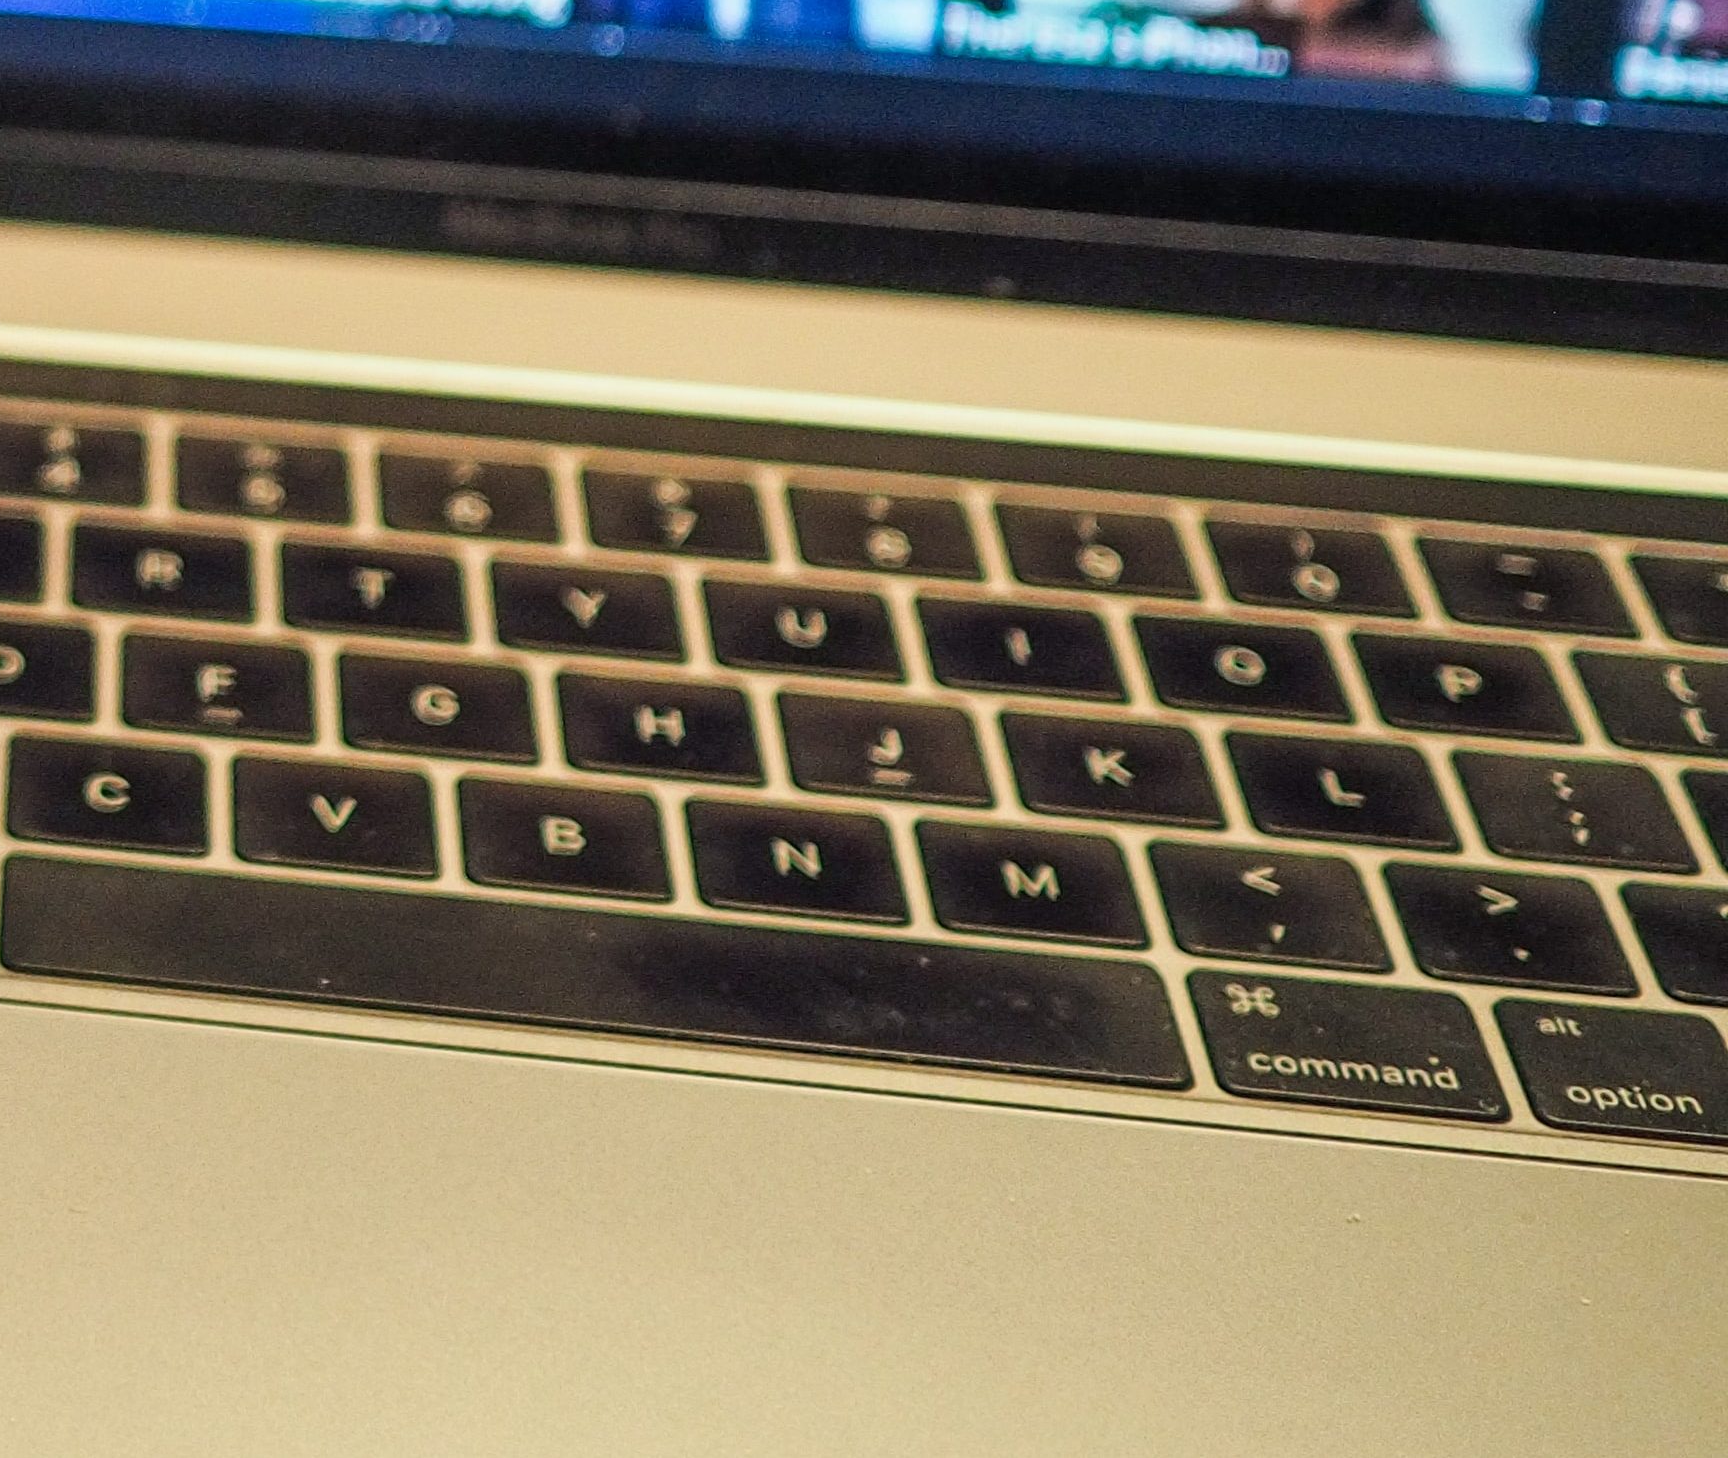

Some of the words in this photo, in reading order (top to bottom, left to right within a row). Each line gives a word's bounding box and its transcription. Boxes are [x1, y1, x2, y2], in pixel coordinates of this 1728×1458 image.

[136, 549, 183, 586] R
[351, 567, 392, 606] T
[566, 586, 607, 626] Y
[776, 607, 829, 646] U
[1006, 627, 1033, 665] I
[196, 663, 236, 700] F
[1215, 645, 1267, 685] O
[1437, 663, 1484, 701] P
[411, 684, 461, 723] G
[634, 705, 687, 744] H
[869, 727, 905, 765] J
[1084, 746, 1134, 786] K
[84, 772, 131, 810] C
[1319, 767, 1366, 808] L
[310, 793, 358, 832] V
[540, 814, 587, 855] B
[771, 837, 823, 879] N
[1000, 859, 1061, 901] M
[1240, 864, 1283, 896] <
[1476, 883, 1520, 916] >
[1537, 1015, 1583, 1038] alt
[1246, 1048, 1461, 1094] command
[1564, 1084, 1704, 1116] option
